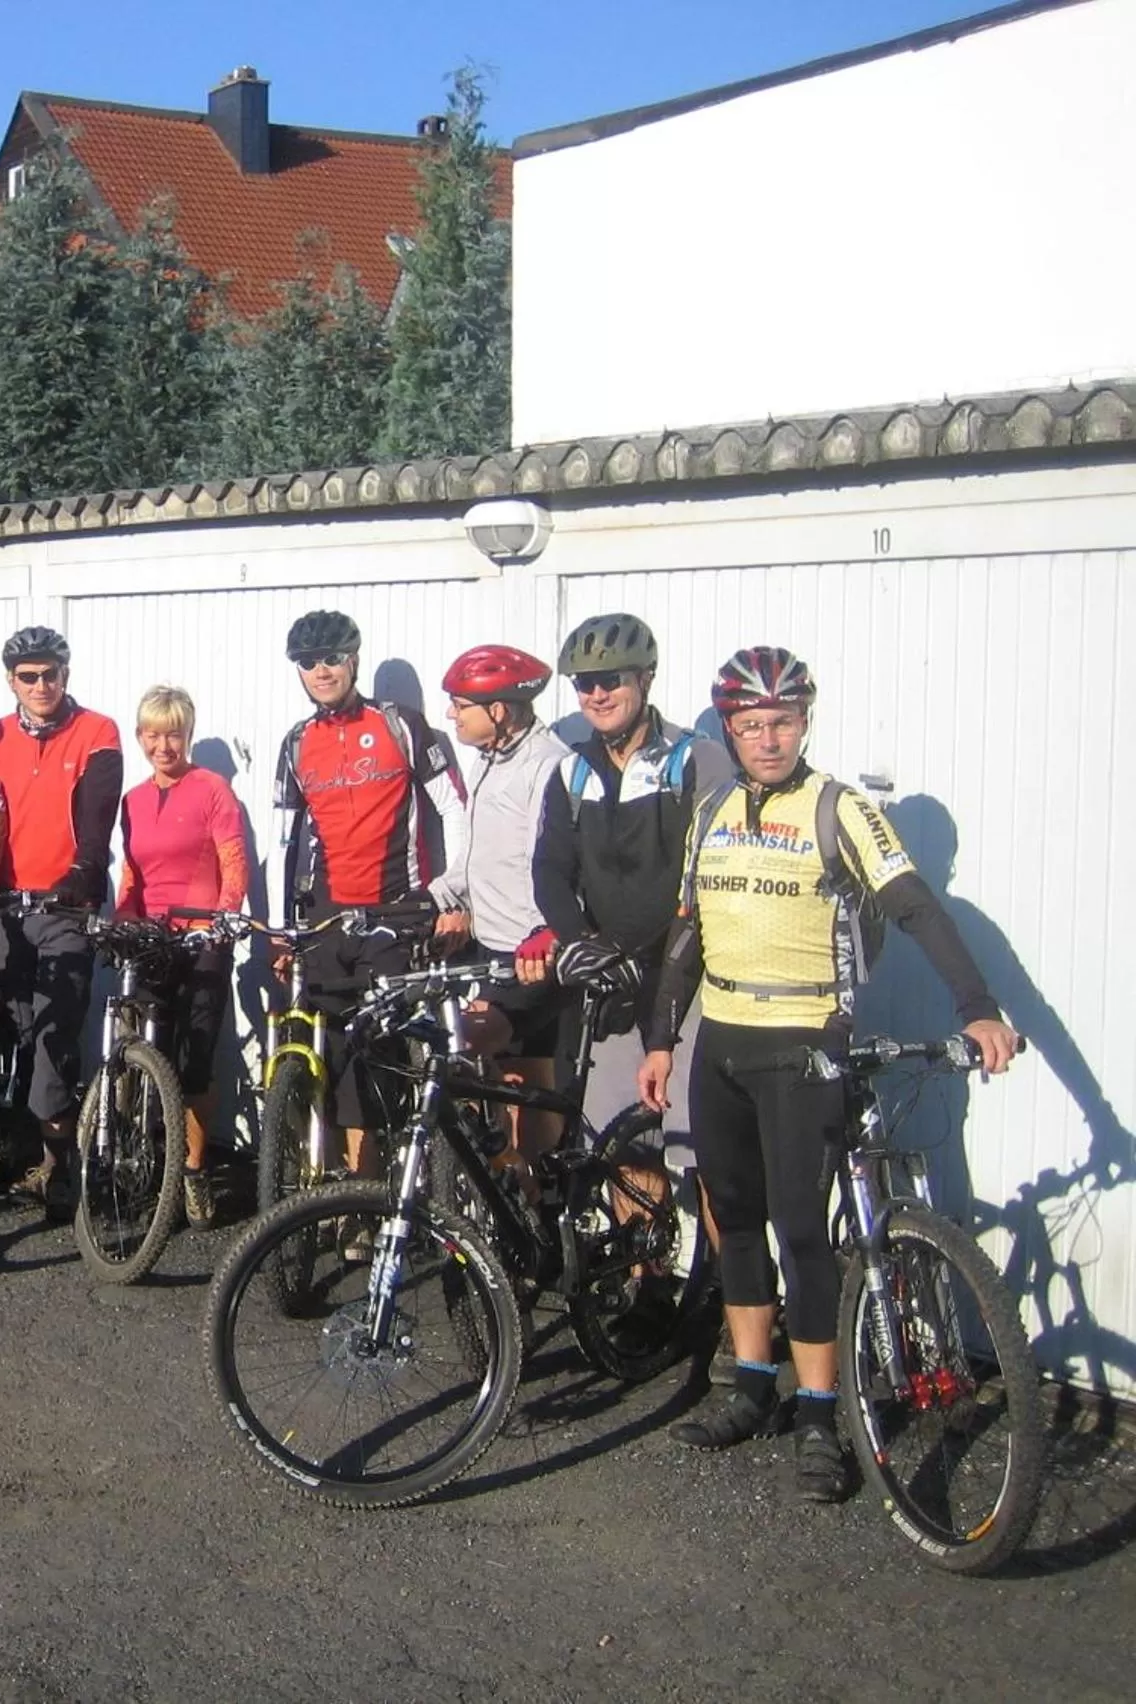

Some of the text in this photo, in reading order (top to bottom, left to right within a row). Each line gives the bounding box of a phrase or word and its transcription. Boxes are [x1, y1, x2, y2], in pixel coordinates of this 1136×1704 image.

[872, 527, 891, 555] 10
[727, 832, 813, 855] TRANSALP
[753, 877, 800, 897] 2008
